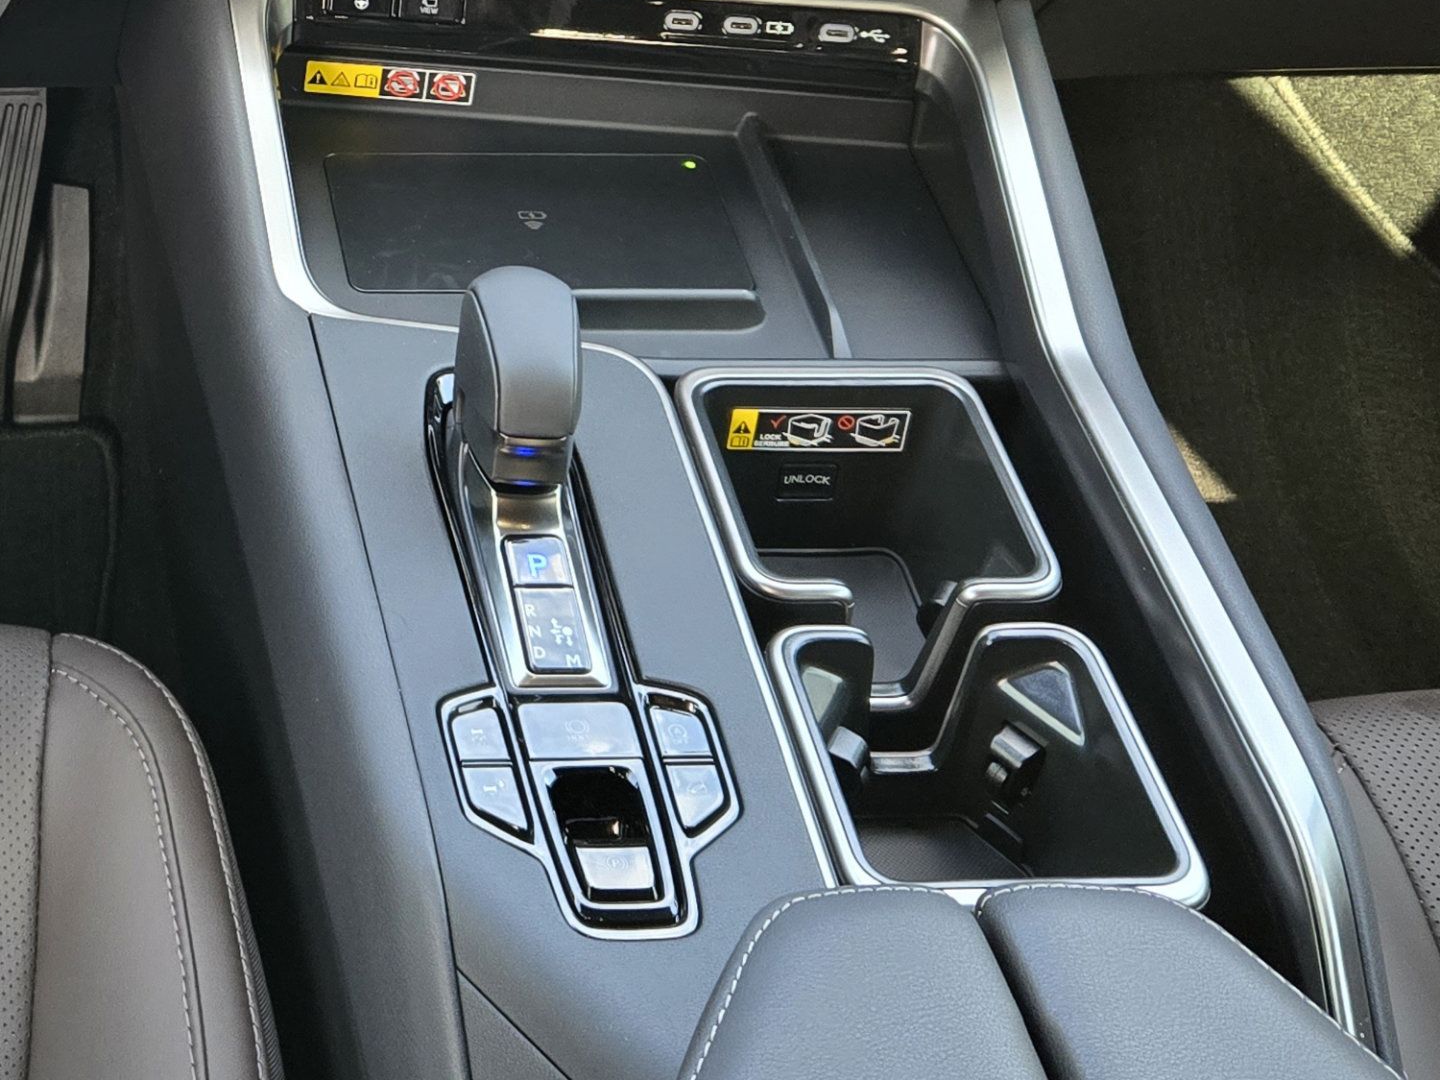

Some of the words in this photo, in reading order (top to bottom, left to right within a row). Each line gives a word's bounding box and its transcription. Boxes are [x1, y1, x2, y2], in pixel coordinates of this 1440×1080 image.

[783, 474, 831, 486] UNLOCK
[527, 553, 547, 578] P
[524, 603, 537, 617] R
[528, 624, 542, 638] N
[533, 646, 545, 659] D
[565, 654, 582, 667] M
